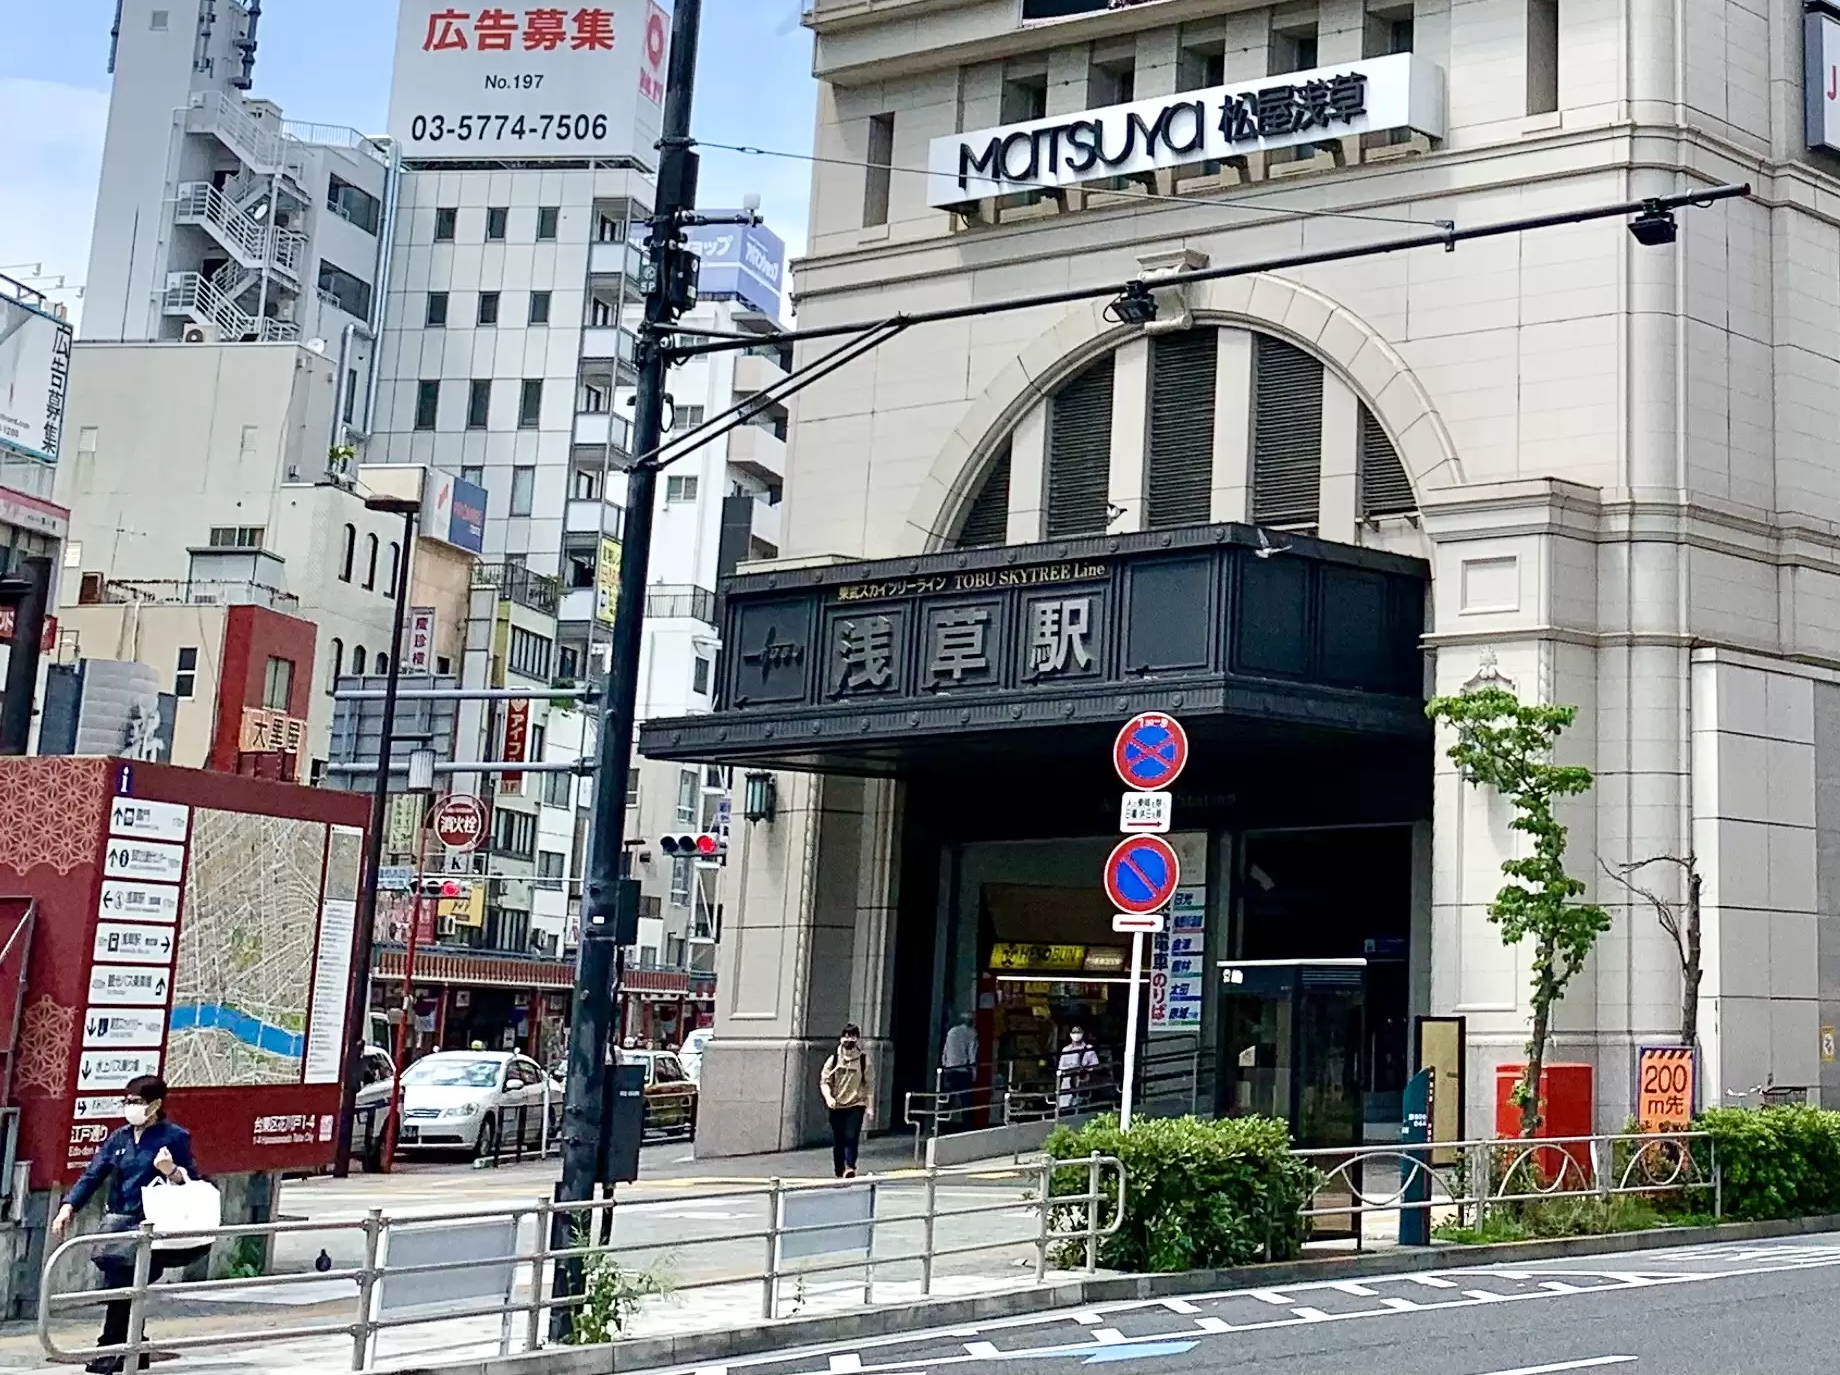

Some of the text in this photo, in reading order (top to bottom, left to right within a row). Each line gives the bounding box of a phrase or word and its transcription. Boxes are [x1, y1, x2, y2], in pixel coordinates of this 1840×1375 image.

[422, 8, 616, 51] 広告募集
[484, 74, 544, 89] No.197
[1218, 72, 1368, 144] 松屋浅草
[411, 113, 608, 142] 03-5774-7506
[954, 571, 996, 591] TOBU
[999, 564, 1070, 586] SKYTREE
[1074, 563, 1106, 579] Line
[838, 598, 1093, 688] 浅草駅
[440, 815, 478, 834] 消火栓
[1644, 1064, 1688, 1094] 200
